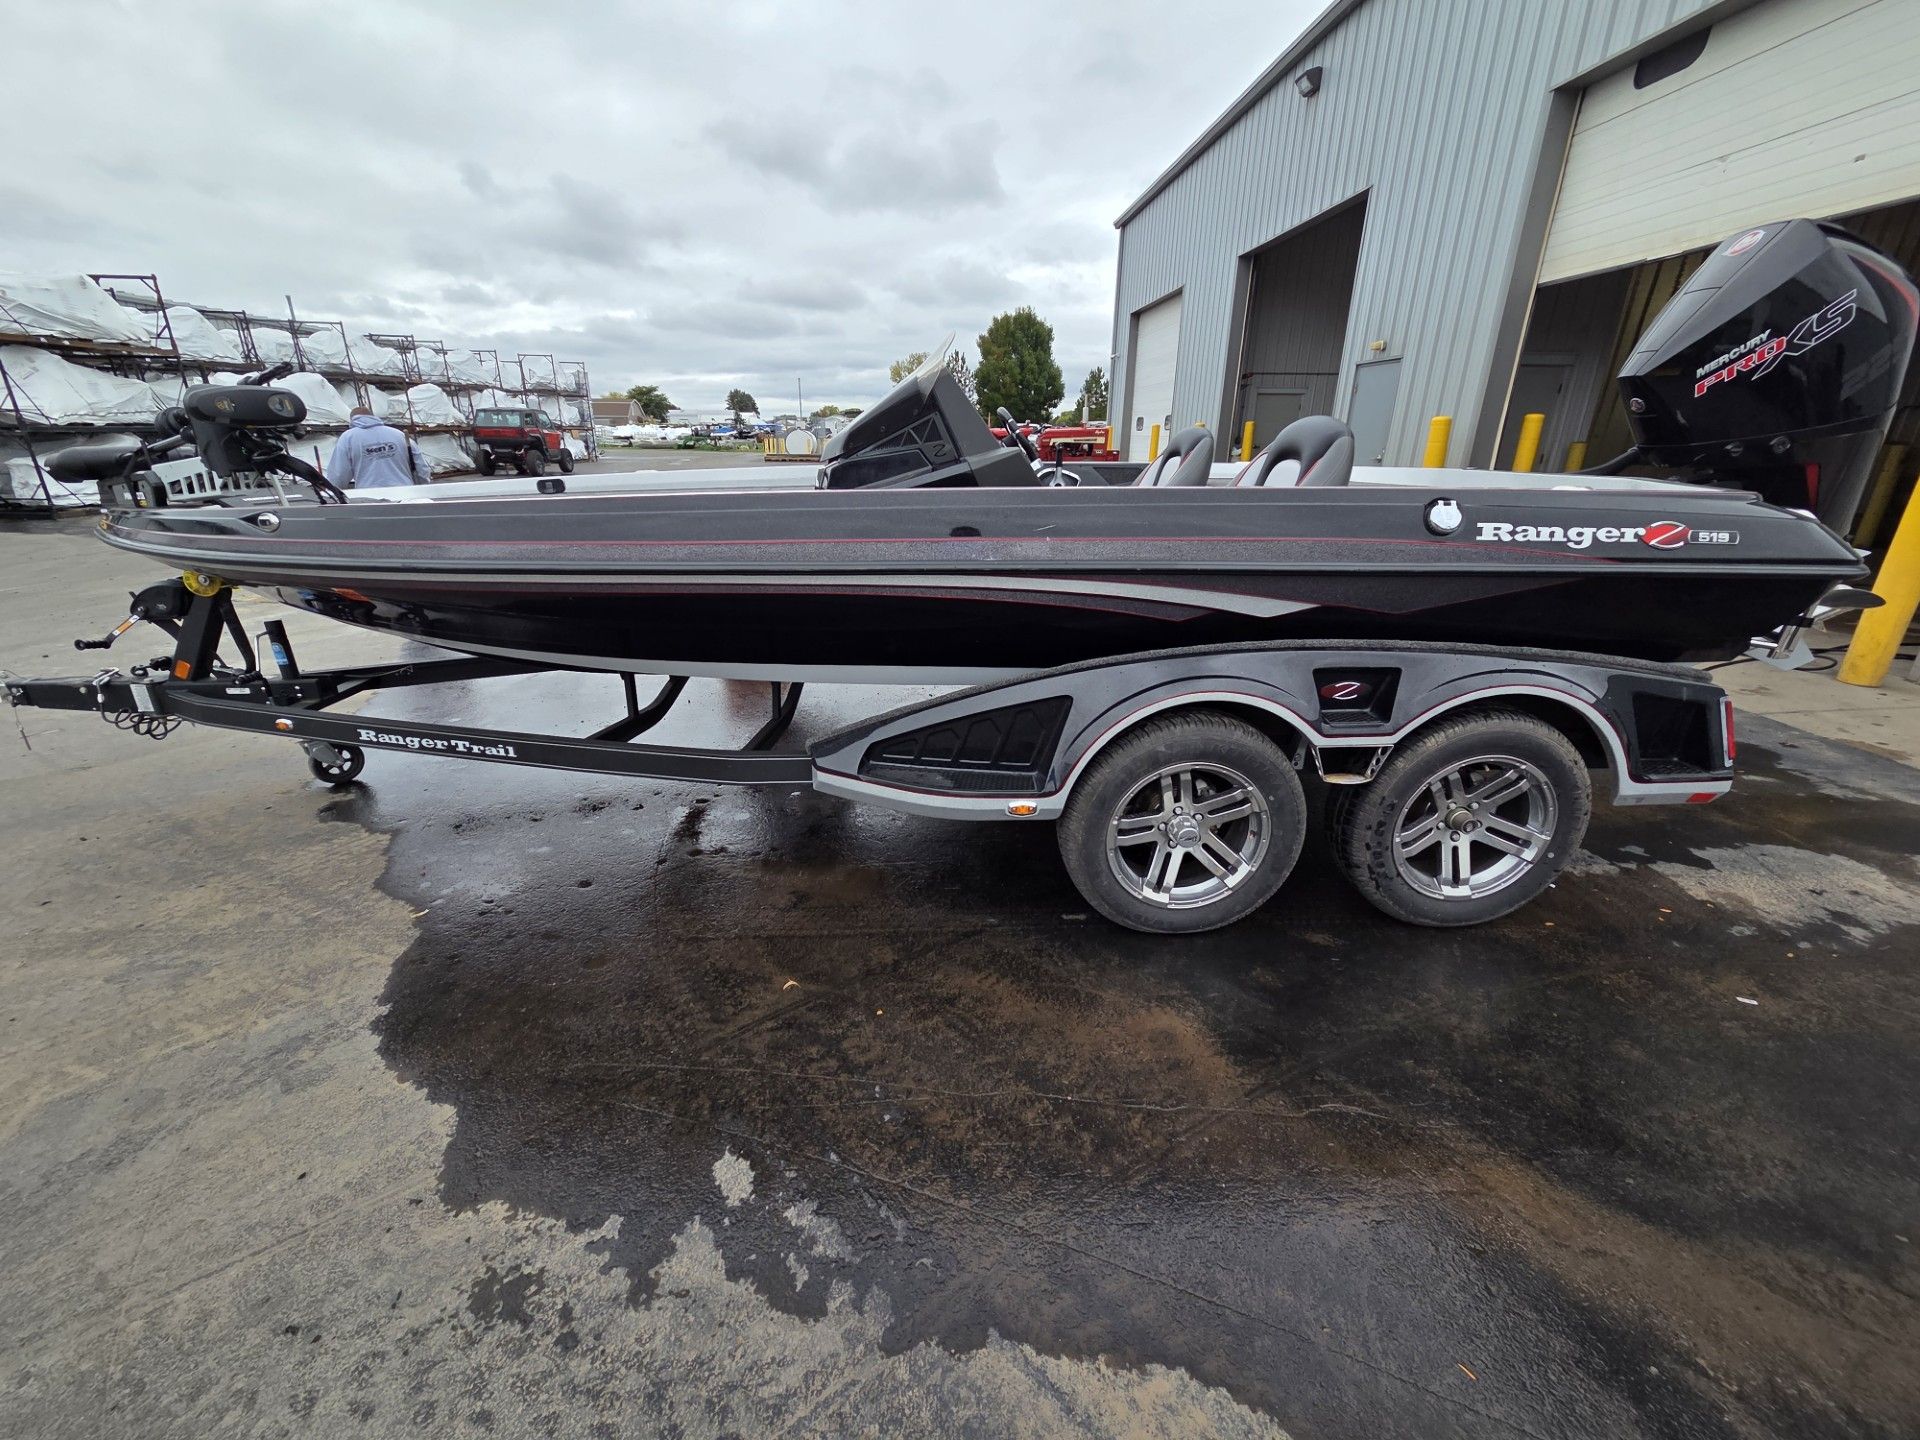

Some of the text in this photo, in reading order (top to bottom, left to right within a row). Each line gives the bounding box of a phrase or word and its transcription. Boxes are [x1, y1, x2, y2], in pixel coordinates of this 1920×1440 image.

[1696, 329, 1772, 378] MERCURY
[1476, 522, 1647, 549] Ranger
[1698, 531, 1730, 543] 519
[356, 729, 518, 758] Ranger Trail
